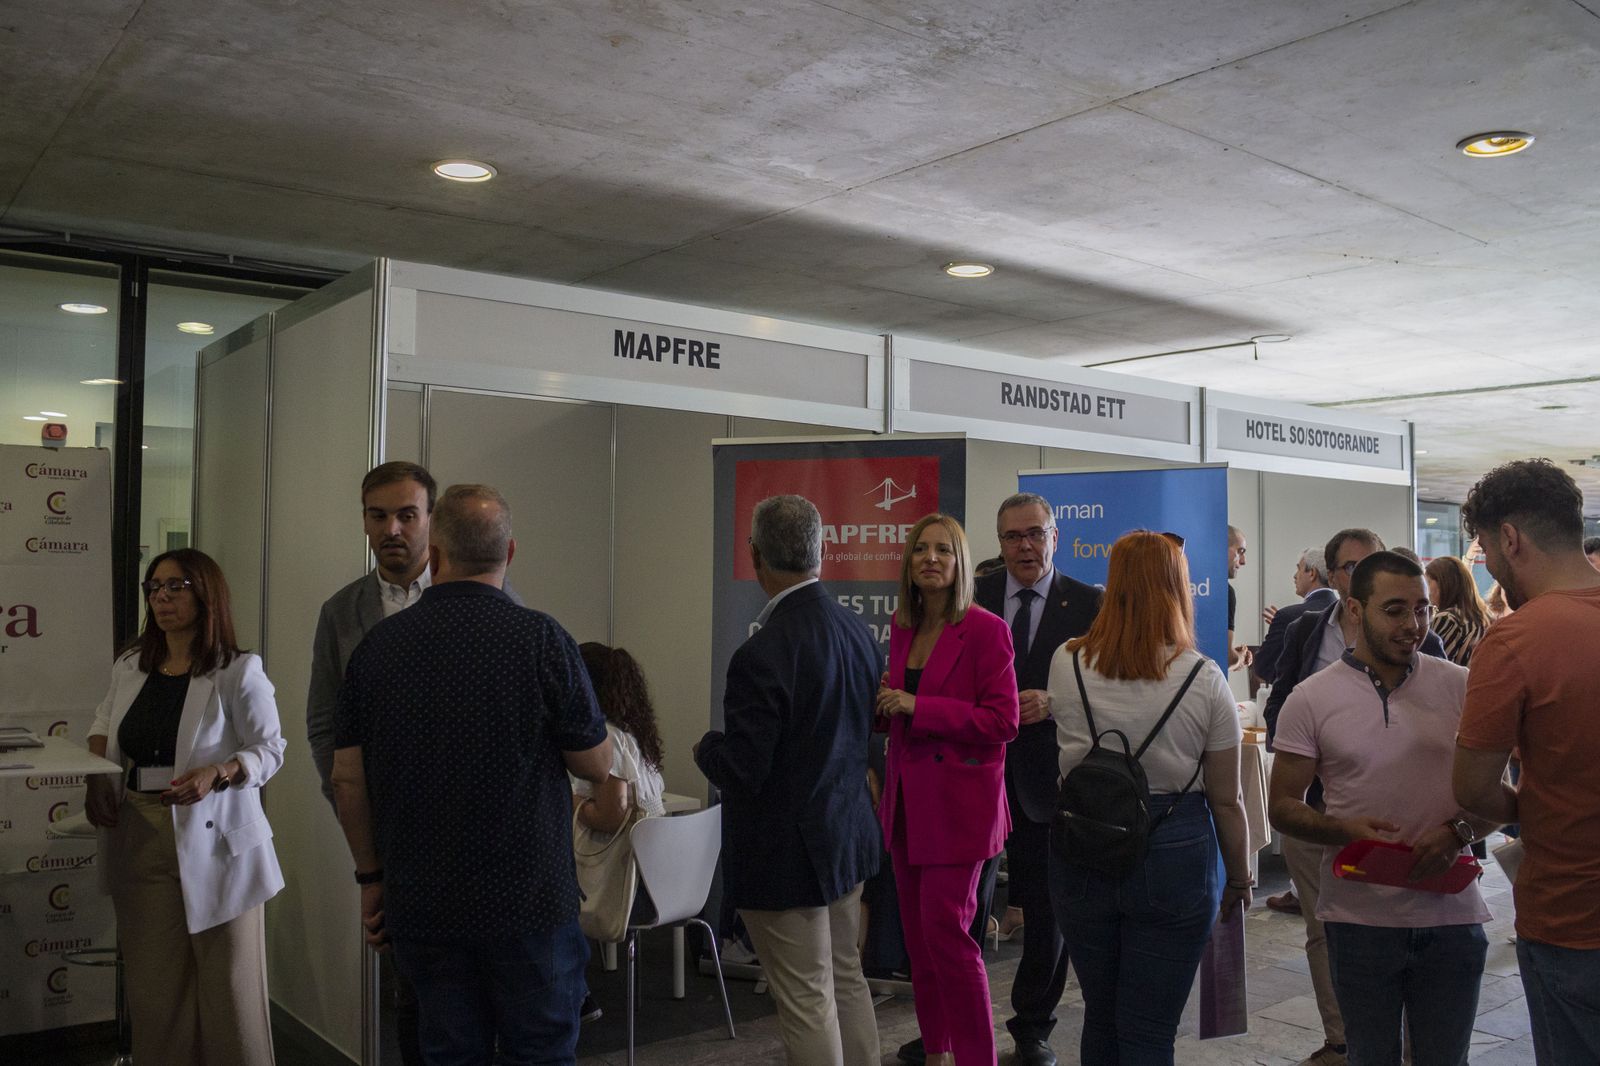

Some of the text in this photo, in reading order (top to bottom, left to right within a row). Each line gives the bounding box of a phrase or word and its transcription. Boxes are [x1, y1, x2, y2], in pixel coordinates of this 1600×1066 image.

[614, 329, 720, 369] MAPFRE
[1001, 381, 1126, 420] RANDSTAD ETT
[1246, 419, 1380, 454] HOTEL SO/SOTOGRANDE
[25, 463, 88, 479] Cámara
[1053, 503, 1104, 520] uman
[822, 523, 915, 544] APFRE
[25, 537, 89, 553] Cámara
[1072, 538, 1113, 559] forw
[835, 551, 861, 563] global
[863, 551, 873, 561] de
[869, 595, 899, 615] TU
